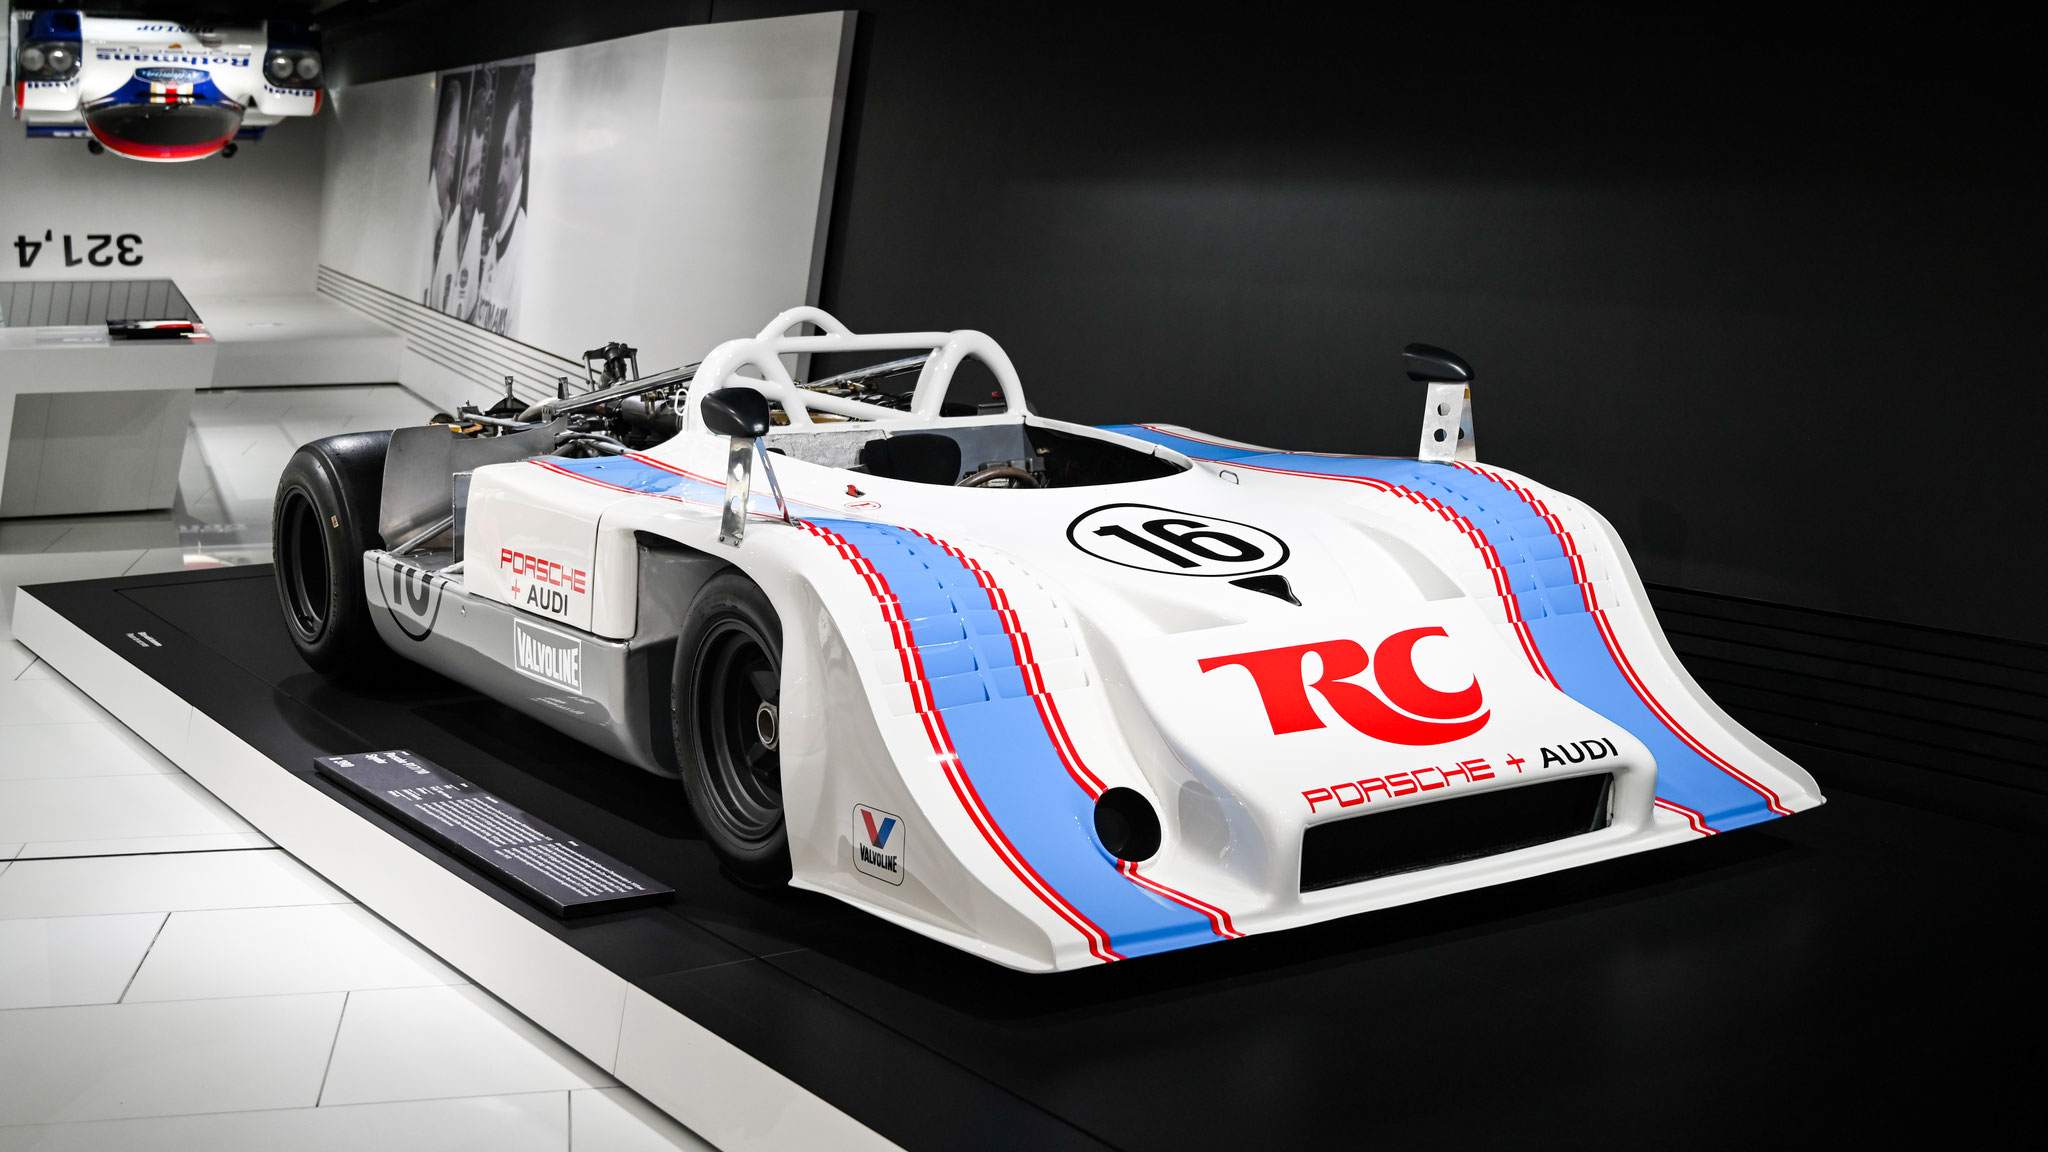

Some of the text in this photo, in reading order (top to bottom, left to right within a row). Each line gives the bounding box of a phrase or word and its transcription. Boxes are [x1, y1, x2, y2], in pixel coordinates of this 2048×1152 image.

[137, 25, 214, 34] DUNLOP
[96, 54, 250, 67] Rothmans
[14, 229, 144, 268] 321,4
[1092, 517, 1265, 569] 16
[500, 548, 586, 594] PORSCHE
[511, 579, 568, 617] + AUDI
[517, 626, 579, 687] VALVOLINE
[1197, 626, 1491, 746] RC
[1301, 737, 1619, 814] PORSCHE + AUDI
[860, 842, 897, 874] VALVOLINE
